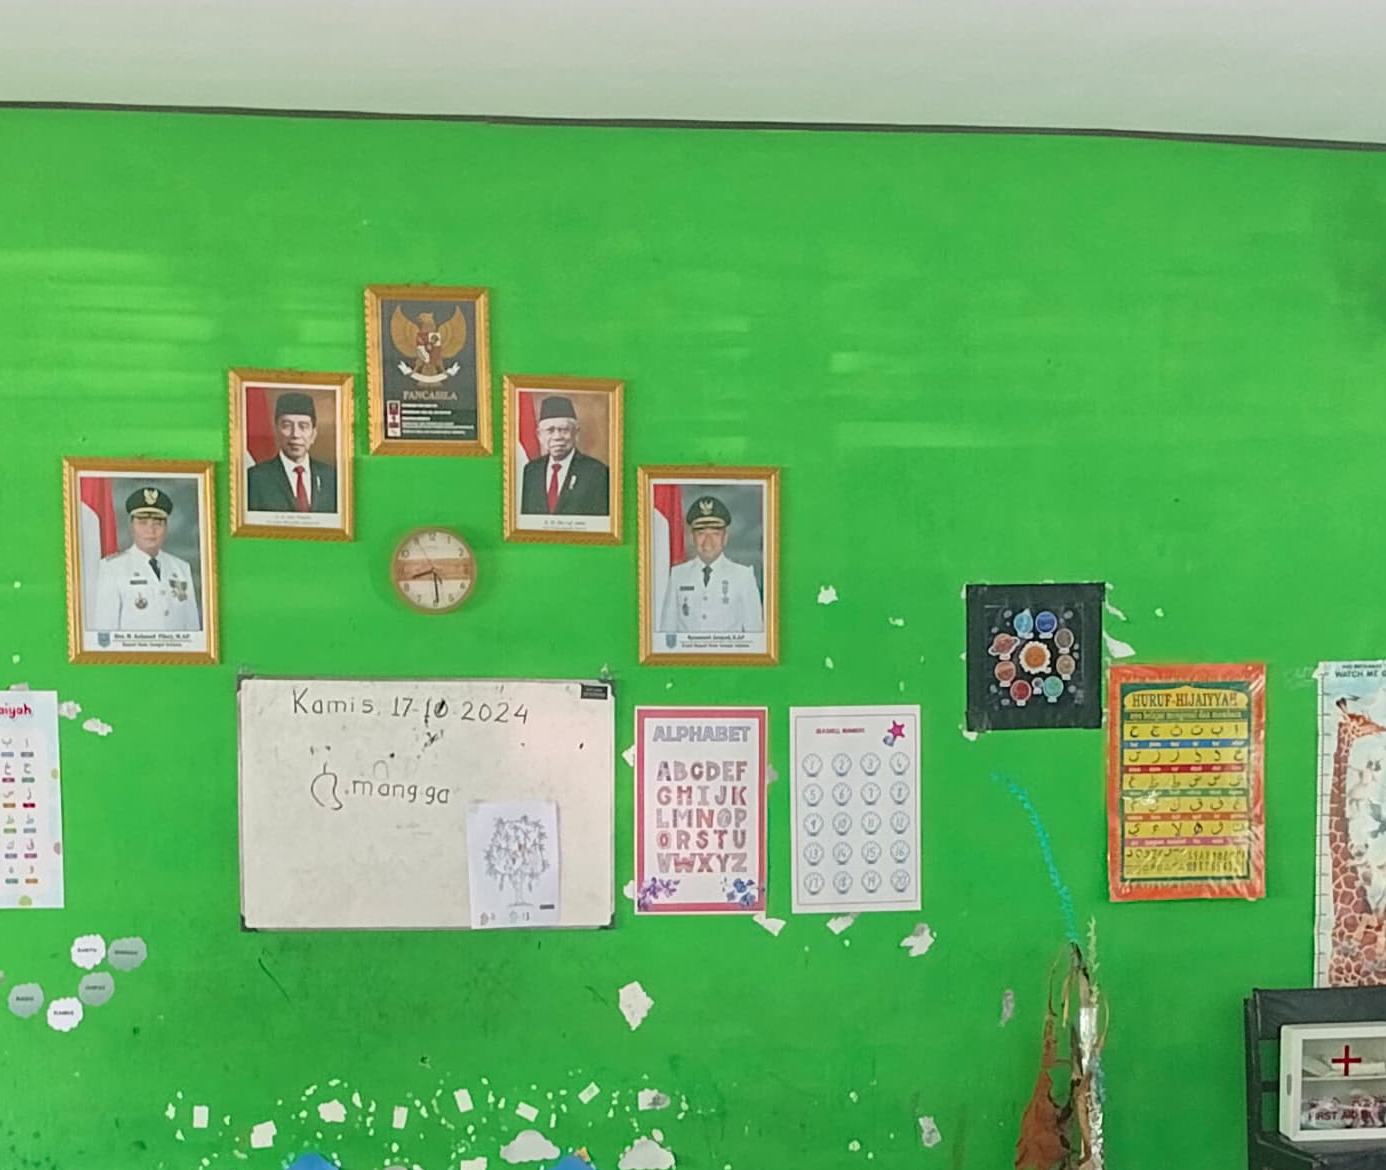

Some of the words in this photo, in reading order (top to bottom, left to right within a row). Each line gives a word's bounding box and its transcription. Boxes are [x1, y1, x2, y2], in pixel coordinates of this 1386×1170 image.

[403, 391, 458, 401] PANCASILA
[653, 726, 751, 742] ALPHABET
[1308, 1111, 1338, 1121] FIRST
